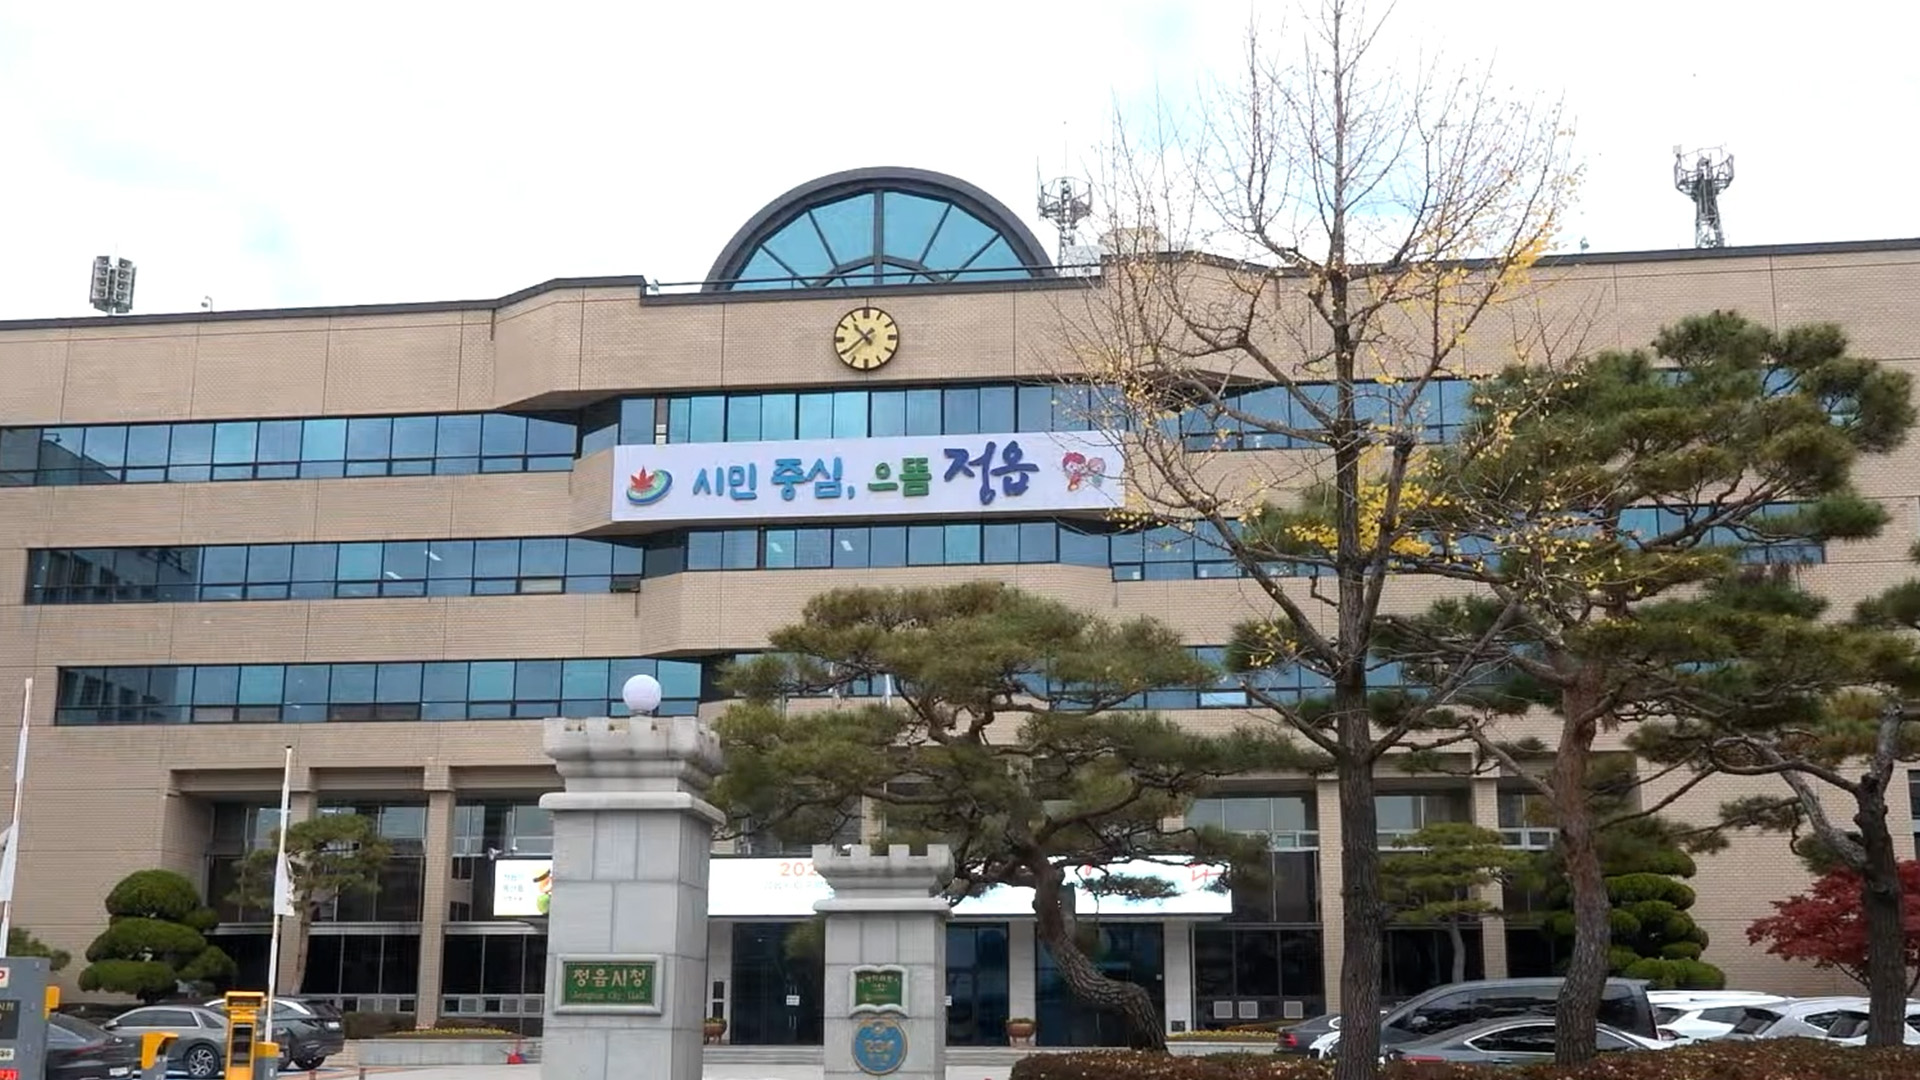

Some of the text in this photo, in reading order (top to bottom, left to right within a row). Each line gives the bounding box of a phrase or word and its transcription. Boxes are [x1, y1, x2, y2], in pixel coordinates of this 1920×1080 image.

[692, 441, 1040, 506] 시민 중심, 으뜸 정읍
[573, 968, 646, 988] 정읍시청
